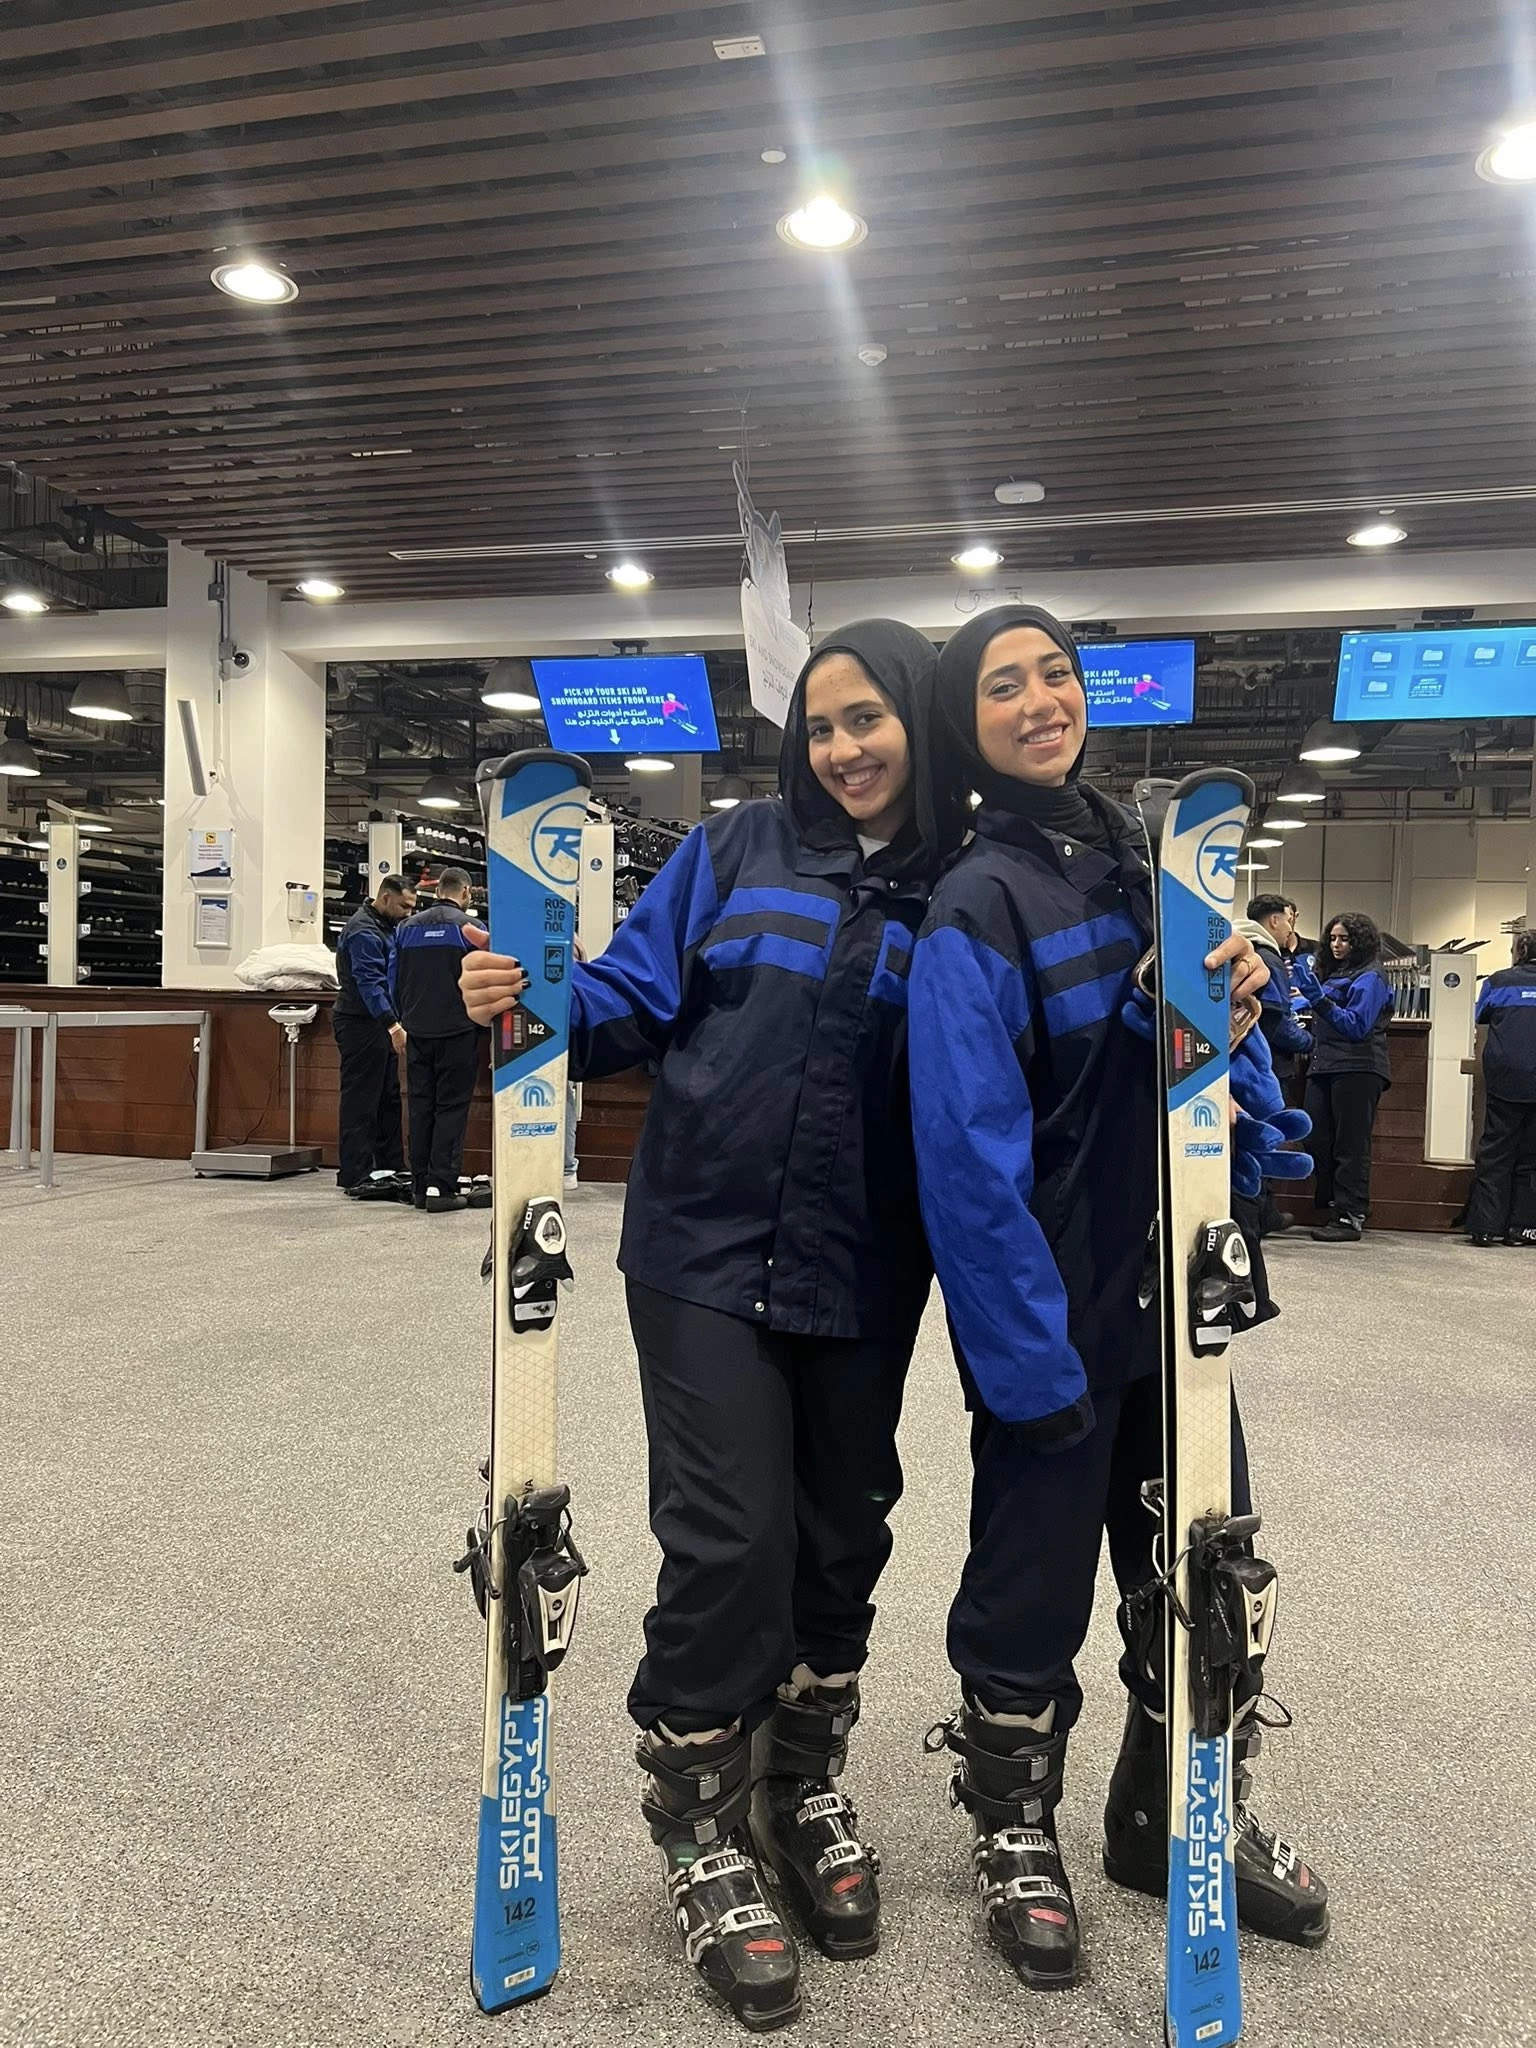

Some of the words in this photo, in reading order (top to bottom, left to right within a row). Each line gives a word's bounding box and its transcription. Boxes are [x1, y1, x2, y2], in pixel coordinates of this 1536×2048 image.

[1084, 670, 1099, 678] SKI
[1090, 678, 1114, 686] FROM
[1116, 677, 1138, 685] HERE
[551, 697, 598, 706] SNOWBOARD
[599, 697, 623, 705] ITEMS
[624, 696, 645, 705] FROM
[646, 695, 665, 704] HERE
[563, 688, 594, 696] PICK-UP
[596, 688, 616, 696] YOUR
[617, 688, 630, 696] SKI
[631, 687, 648, 695] AND
[527, 1023, 545, 1035] 142
[1195, 1042, 1210, 1055] 142
[502, 1697, 525, 1823] EGYPT
[1188, 1732, 1209, 1867] EGYPT
[500, 1829, 521, 1890] SKI
[503, 1896, 537, 1925] 142
[1188, 1873, 1206, 1937] SKI
[1192, 1947, 1221, 1975] 142
